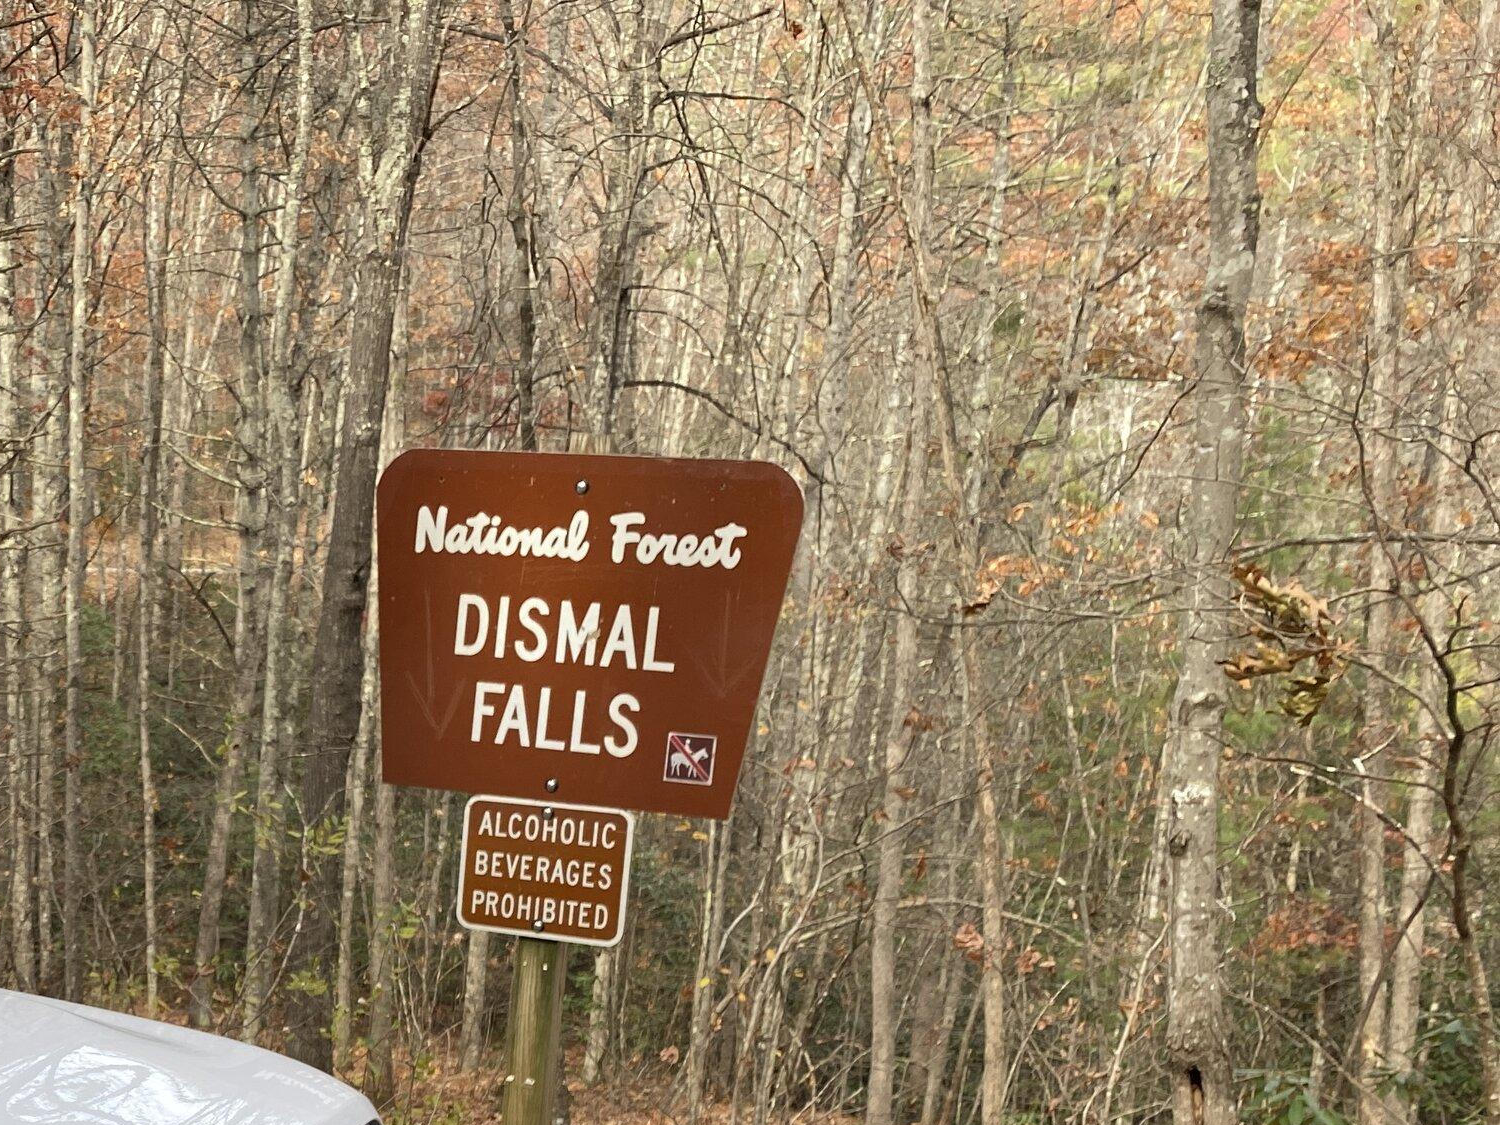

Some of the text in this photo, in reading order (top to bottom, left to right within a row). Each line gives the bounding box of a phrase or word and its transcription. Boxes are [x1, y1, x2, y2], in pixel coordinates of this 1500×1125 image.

[414, 505, 747, 570] National Forest
[454, 593, 675, 673] DISMAL
[471, 681, 641, 759] FALLS
[478, 810, 617, 850] ALCOHOLIC
[474, 851, 612, 890] BEVERAGES
[471, 890, 609, 931] PROHIBITED
